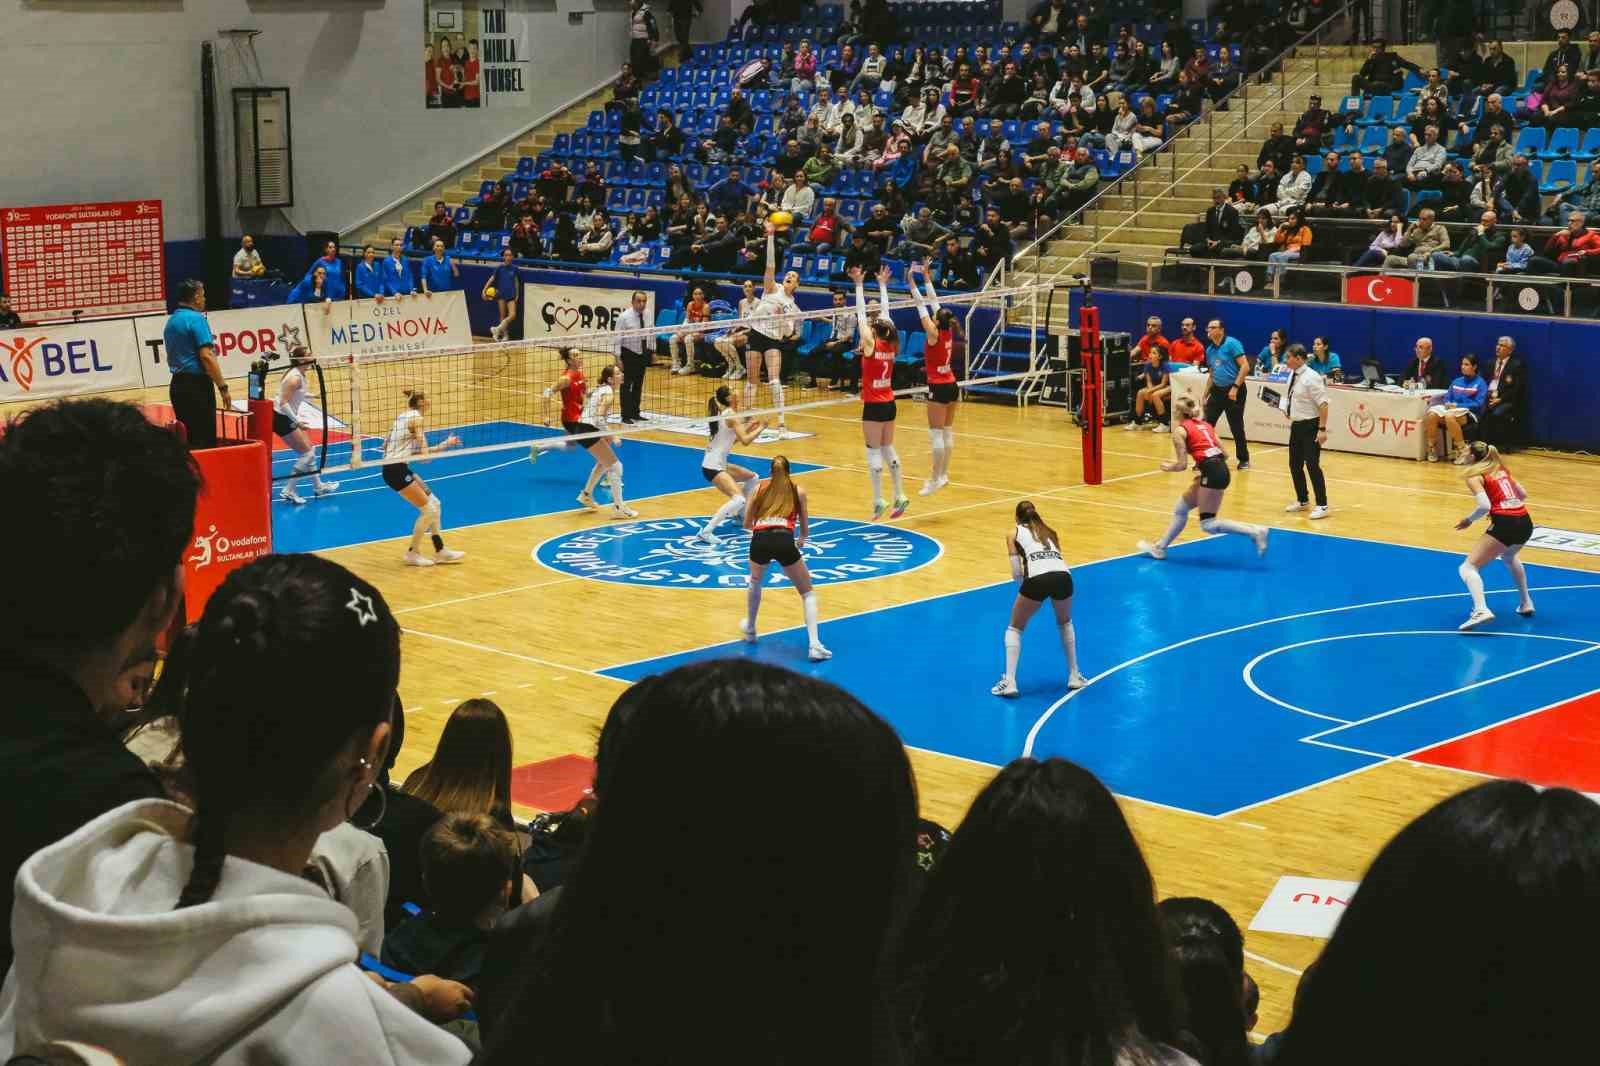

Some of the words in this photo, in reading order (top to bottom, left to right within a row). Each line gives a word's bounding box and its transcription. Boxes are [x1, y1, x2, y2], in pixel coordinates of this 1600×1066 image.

[41, 339, 113, 376] BEL
[1378, 417, 1417, 437] TVF
[231, 535, 267, 547] vodafone
[848, 532, 913, 563] AYDIN
[217, 550, 255, 563] SULTANLAR
